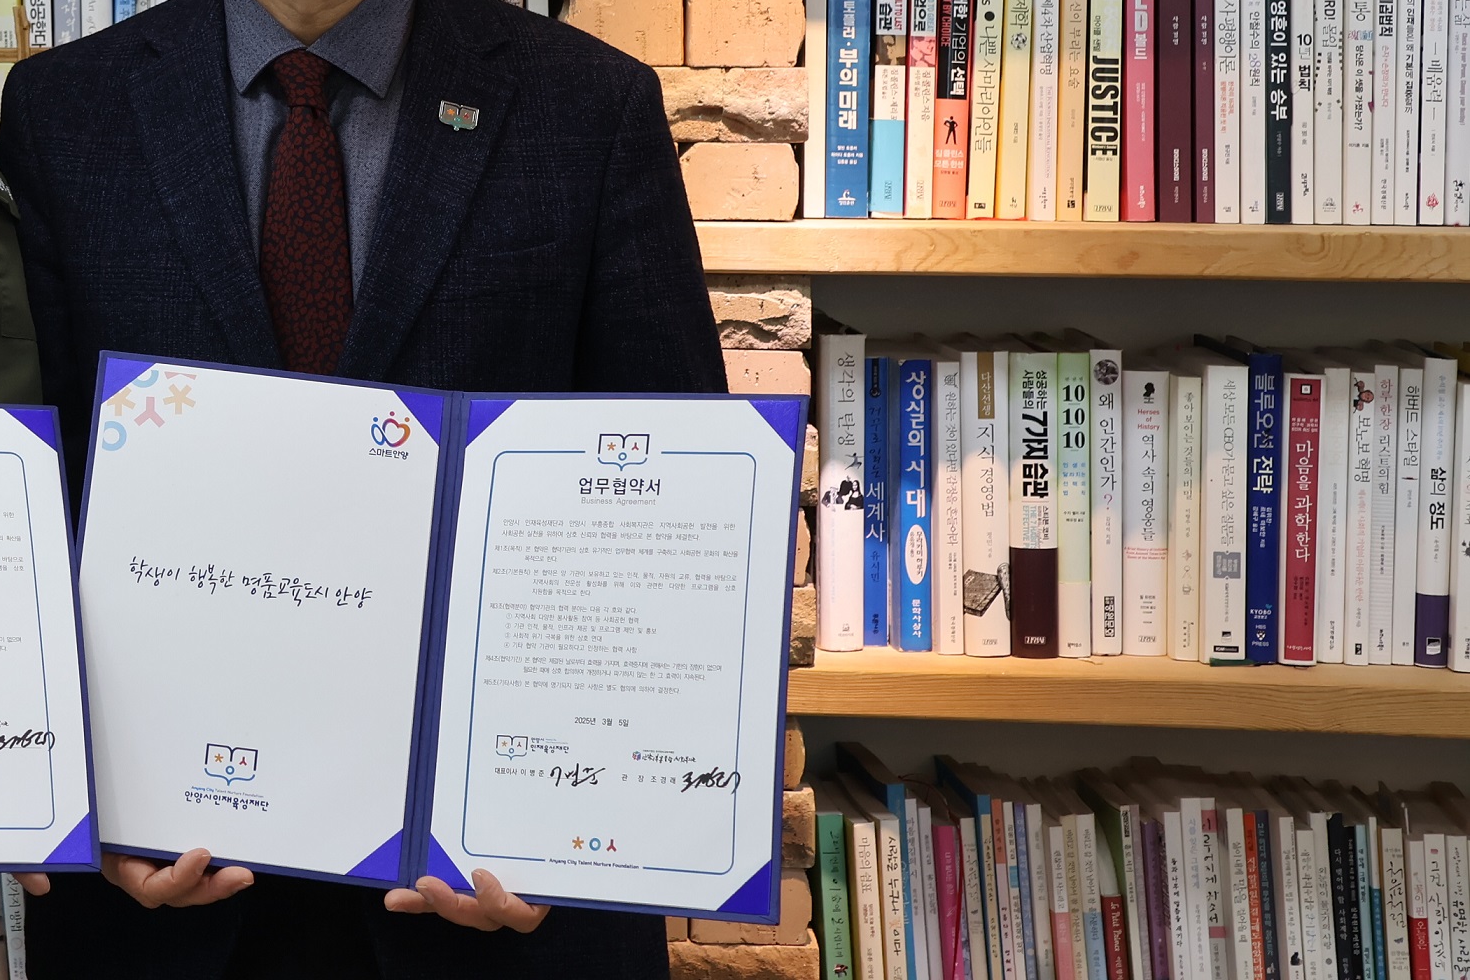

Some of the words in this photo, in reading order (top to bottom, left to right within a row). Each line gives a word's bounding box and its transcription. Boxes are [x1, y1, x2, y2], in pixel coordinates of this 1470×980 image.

[880, 6, 893, 31] 습관
[943, 5, 951, 15] BY
[1271, 0, 1287, 47] 영혼이
[941, 17, 950, 47] CHOICE
[952, 24, 967, 62] 기업의
[839, 50, 858, 86] 부의
[1271, 54, 1287, 84] 있는
[838, 92, 857, 130] 미래
[1091, 55, 1119, 156] JUSTICE
[1271, 90, 1287, 120] 승부
[838, 352, 856, 404] 생각의
[1063, 385, 1085, 402] 10
[906, 371, 926, 456] 상실의
[1063, 408, 1085, 426] 10
[1137, 423, 1160, 431] History
[1254, 374, 1276, 450] 블루오션
[838, 413, 855, 447] 탄생
[1022, 411, 1049, 460] 7가지
[1063, 431, 1085, 449] 10
[368, 447, 409, 460] 스마트안양
[1296, 441, 1313, 491] 마음을
[579, 478, 662, 496] 업무협약서
[906, 461, 926, 518] 시대
[1022, 463, 1049, 498] 습관
[1253, 456, 1273, 494] 전략
[1430, 467, 1446, 496] 삶의
[581, 497, 613, 505] Business
[616, 497, 656, 506] Agreement
[1430, 501, 1445, 531] 정도
[1295, 496, 1311, 563] 과학한다
[129, 556, 181, 587] 학생이
[188, 564, 235, 594] 행복한
[242, 572, 329, 606] 명품교육도시
[335, 586, 373, 608] 안양
[575, 717, 596, 726] 2025년
[602, 718, 612, 726] 3월
[619, 719, 629, 727] 5일
[185, 791, 269, 811] 안양시인재육성재단
